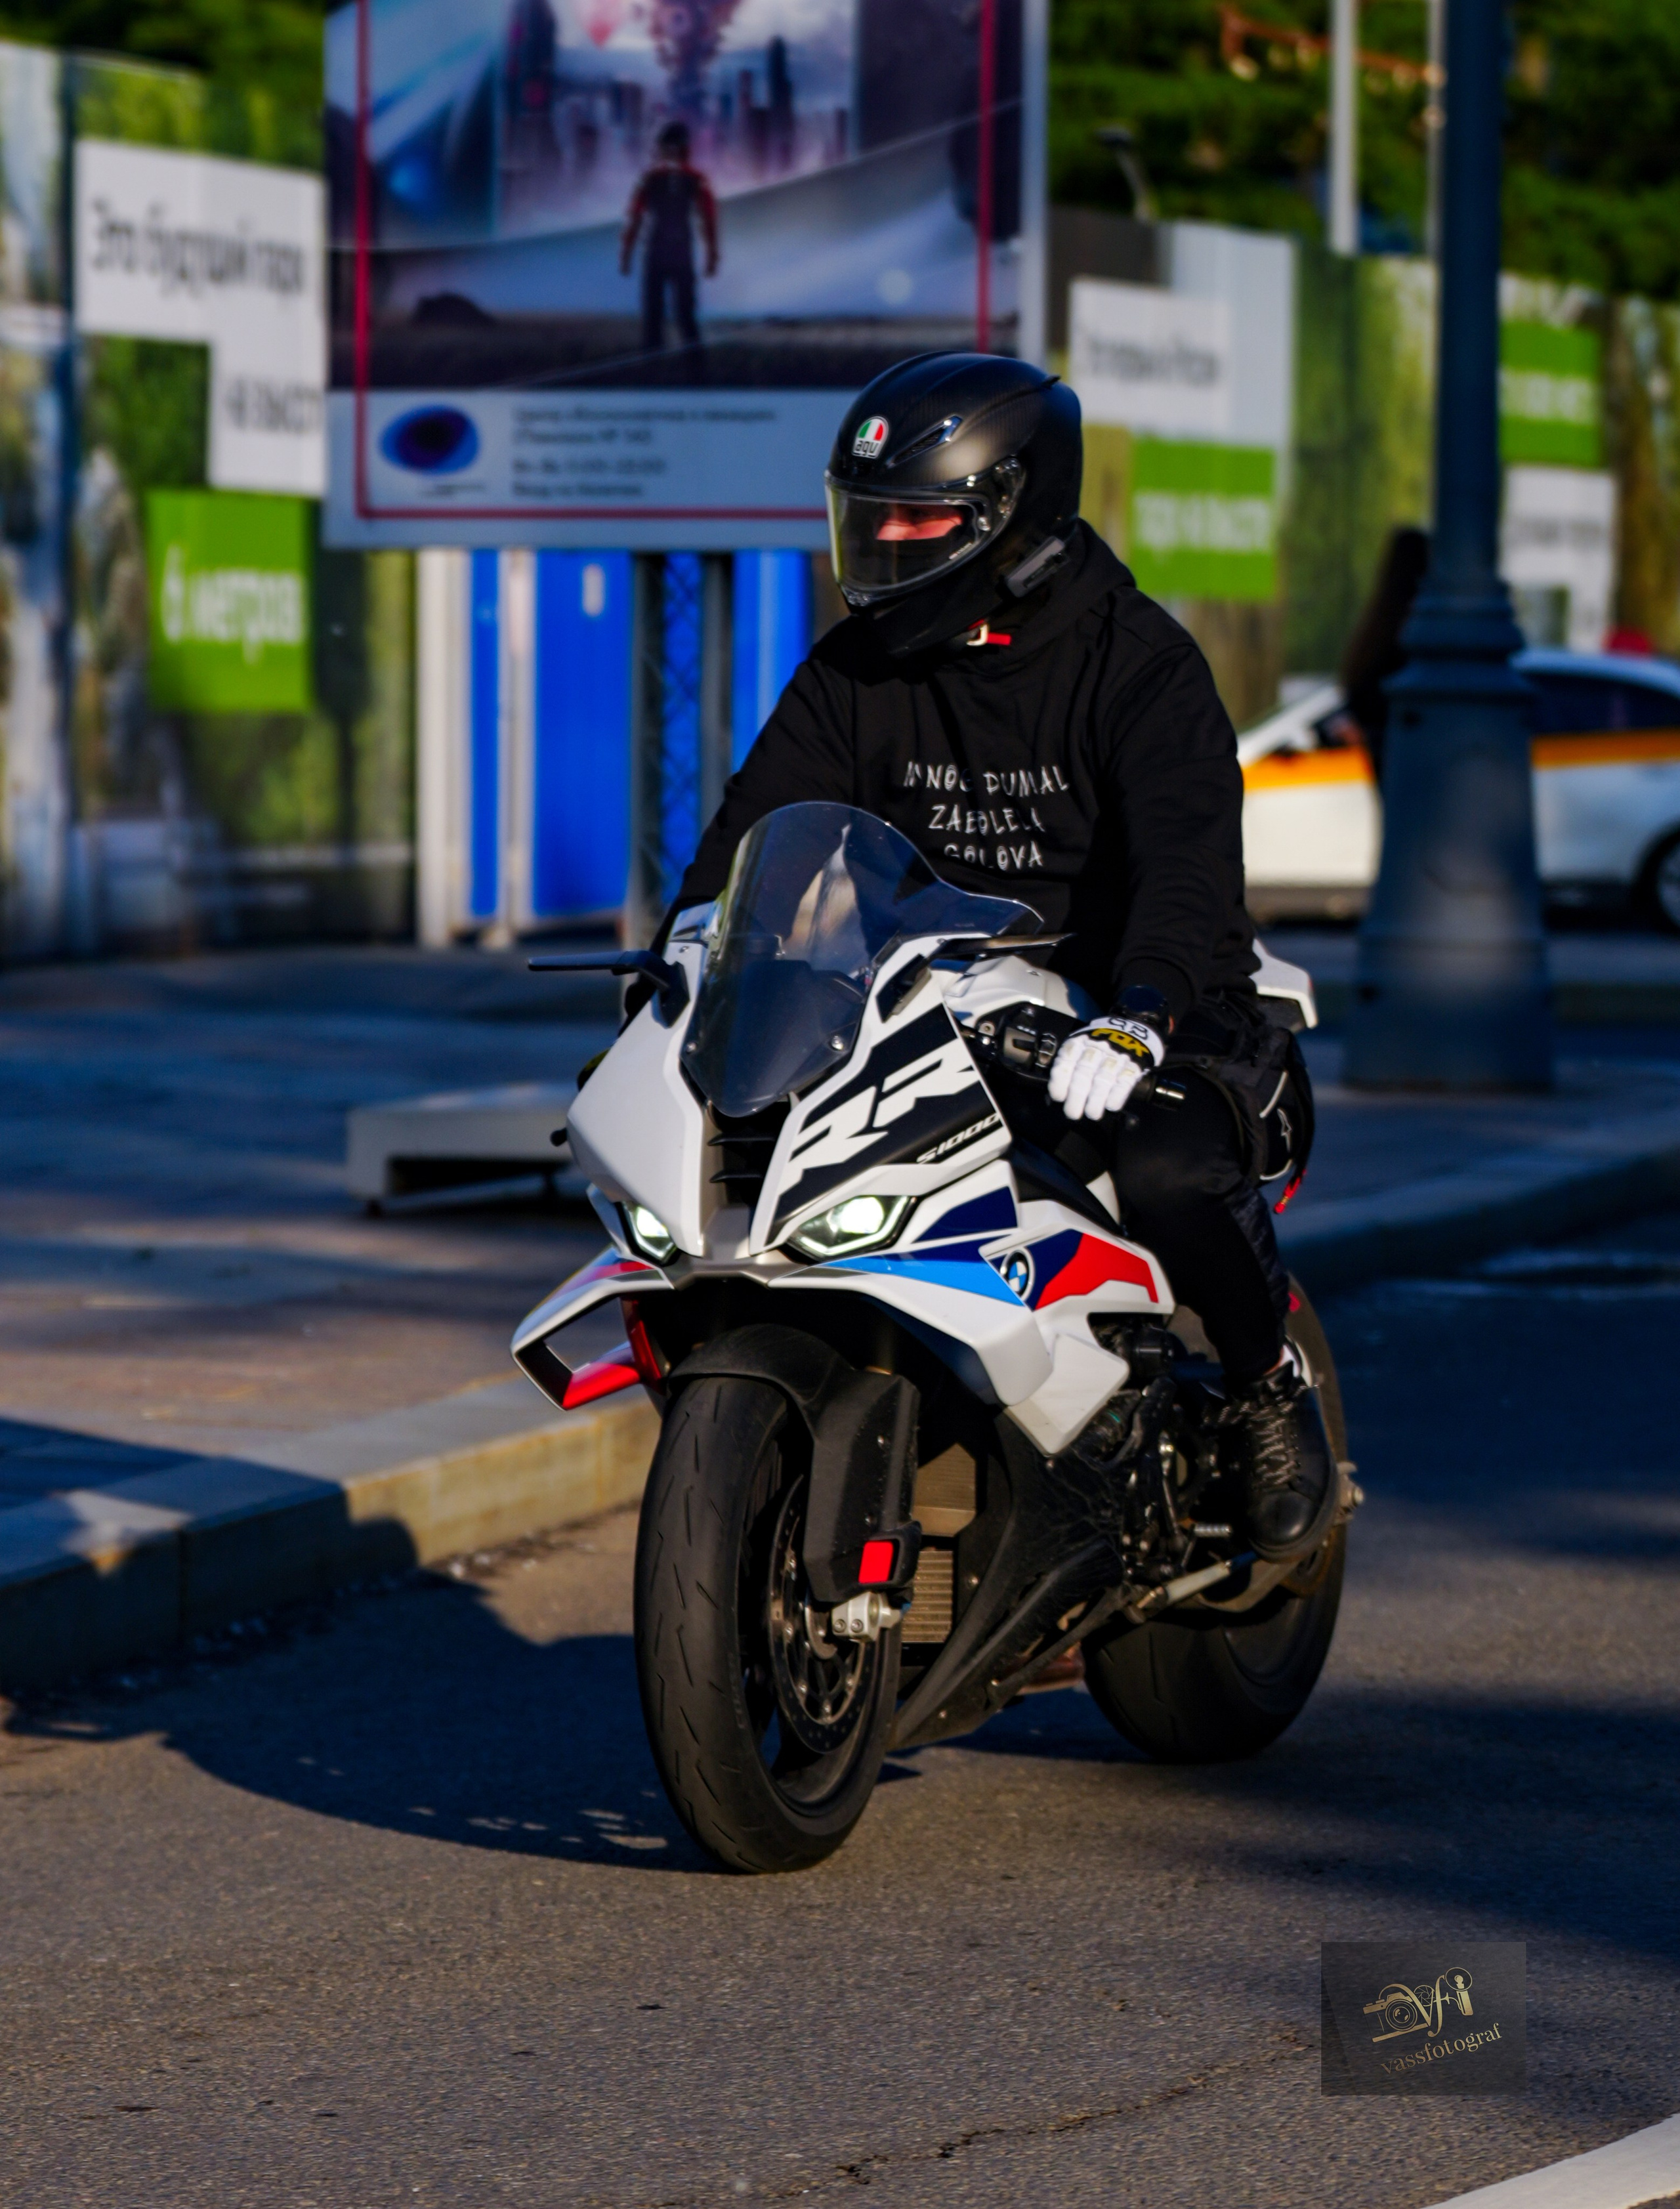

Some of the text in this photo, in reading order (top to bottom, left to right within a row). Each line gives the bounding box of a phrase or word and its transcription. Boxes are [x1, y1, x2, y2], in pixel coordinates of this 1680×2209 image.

[983, 765, 1070, 798] DUMAL
[1091, 1027, 1150, 1058] FOX
[779, 1037, 982, 1196] RR
[916, 1112, 1001, 1164] S1000
